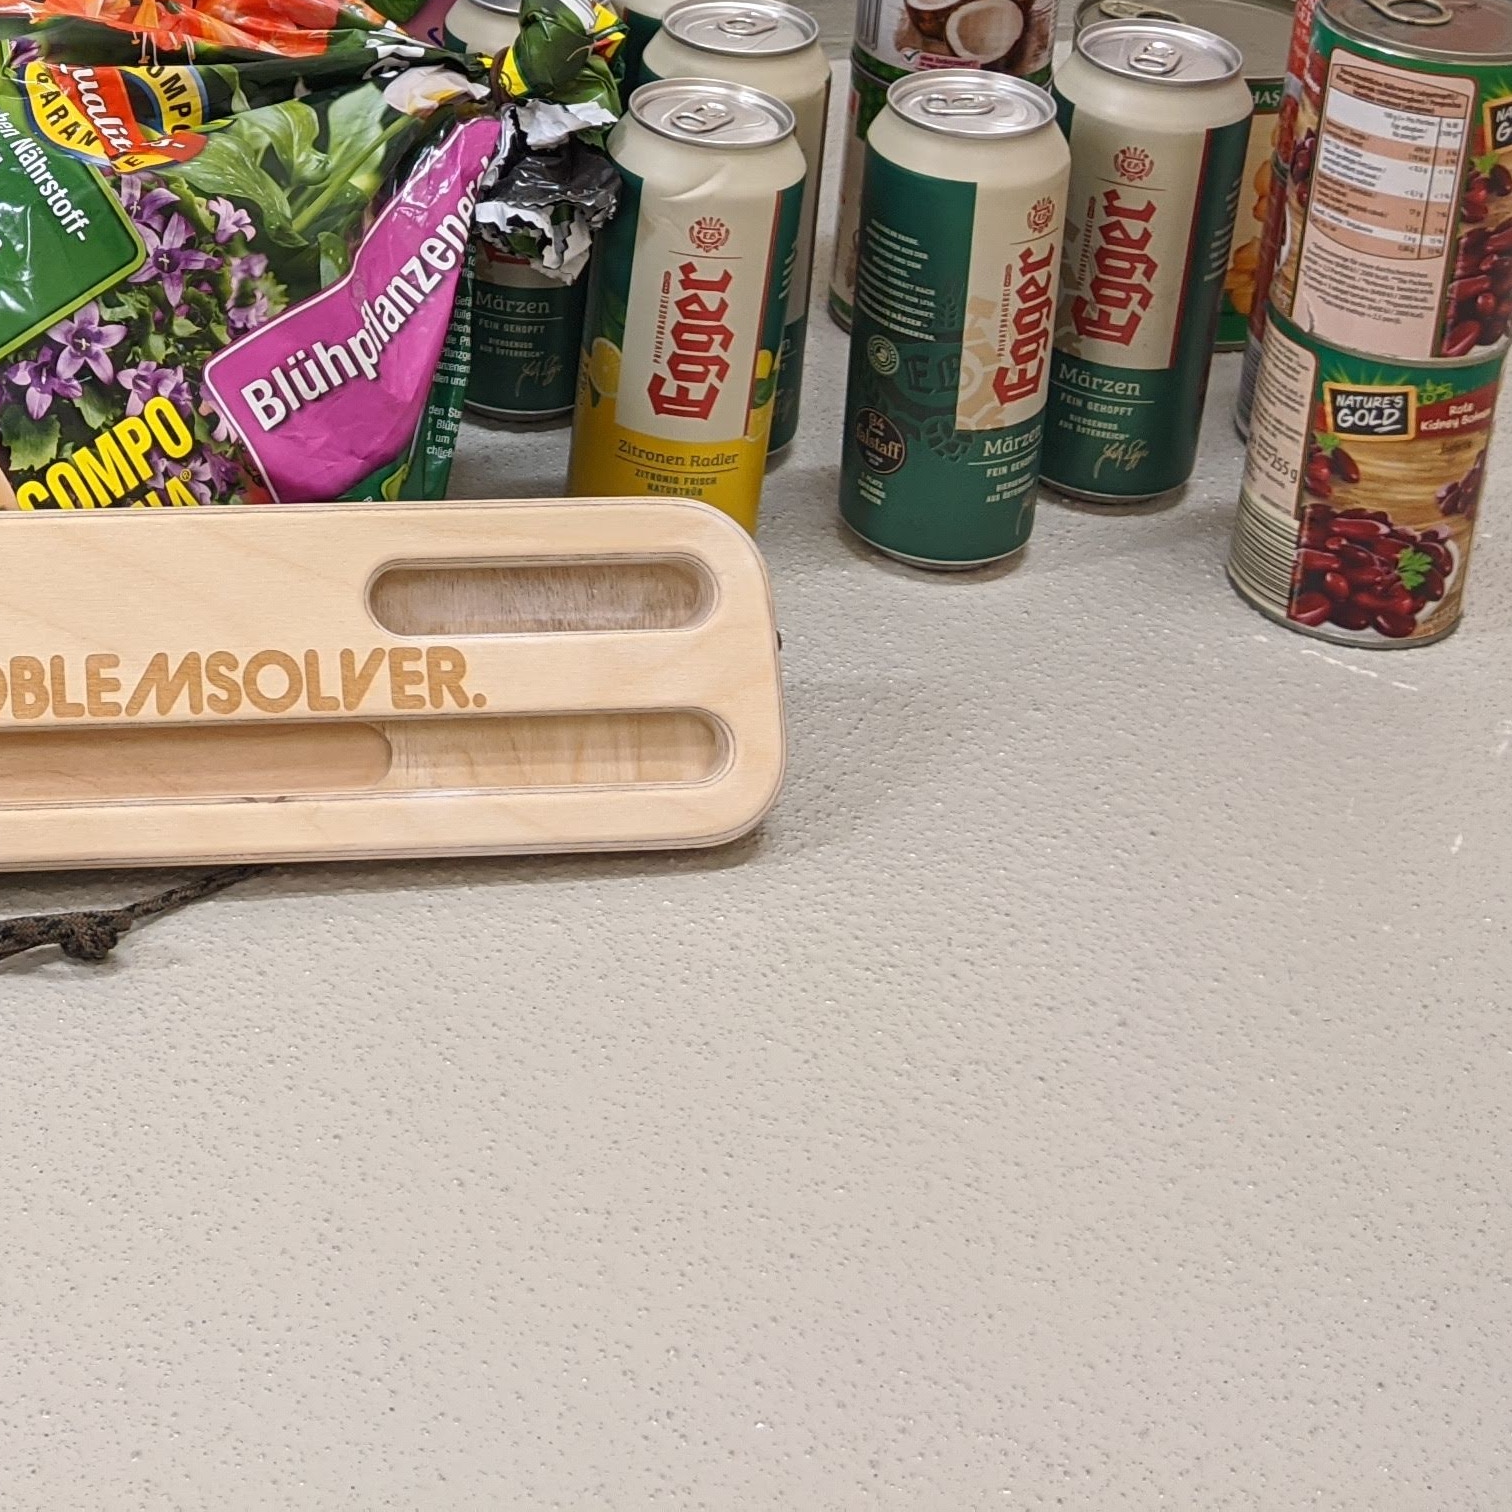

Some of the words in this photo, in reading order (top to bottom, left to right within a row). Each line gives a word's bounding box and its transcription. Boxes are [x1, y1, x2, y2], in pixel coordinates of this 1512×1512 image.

[10, 137, 90, 241] Nährstoff-
[1071, 188, 1158, 346] Egger
[476, 291, 550, 314] Märzen
[992, 242, 1054, 406] Egger
[647, 261, 734, 421] Egger
[1060, 363, 1141, 396] Märzen
[1087, 400, 1134, 416] GEHOPFT
[1336, 394, 1404, 407] NATURE'S
[1337, 408, 1401, 427] GOLD
[618, 439, 686, 467] Zitronen
[690, 453, 739, 468] Radler
